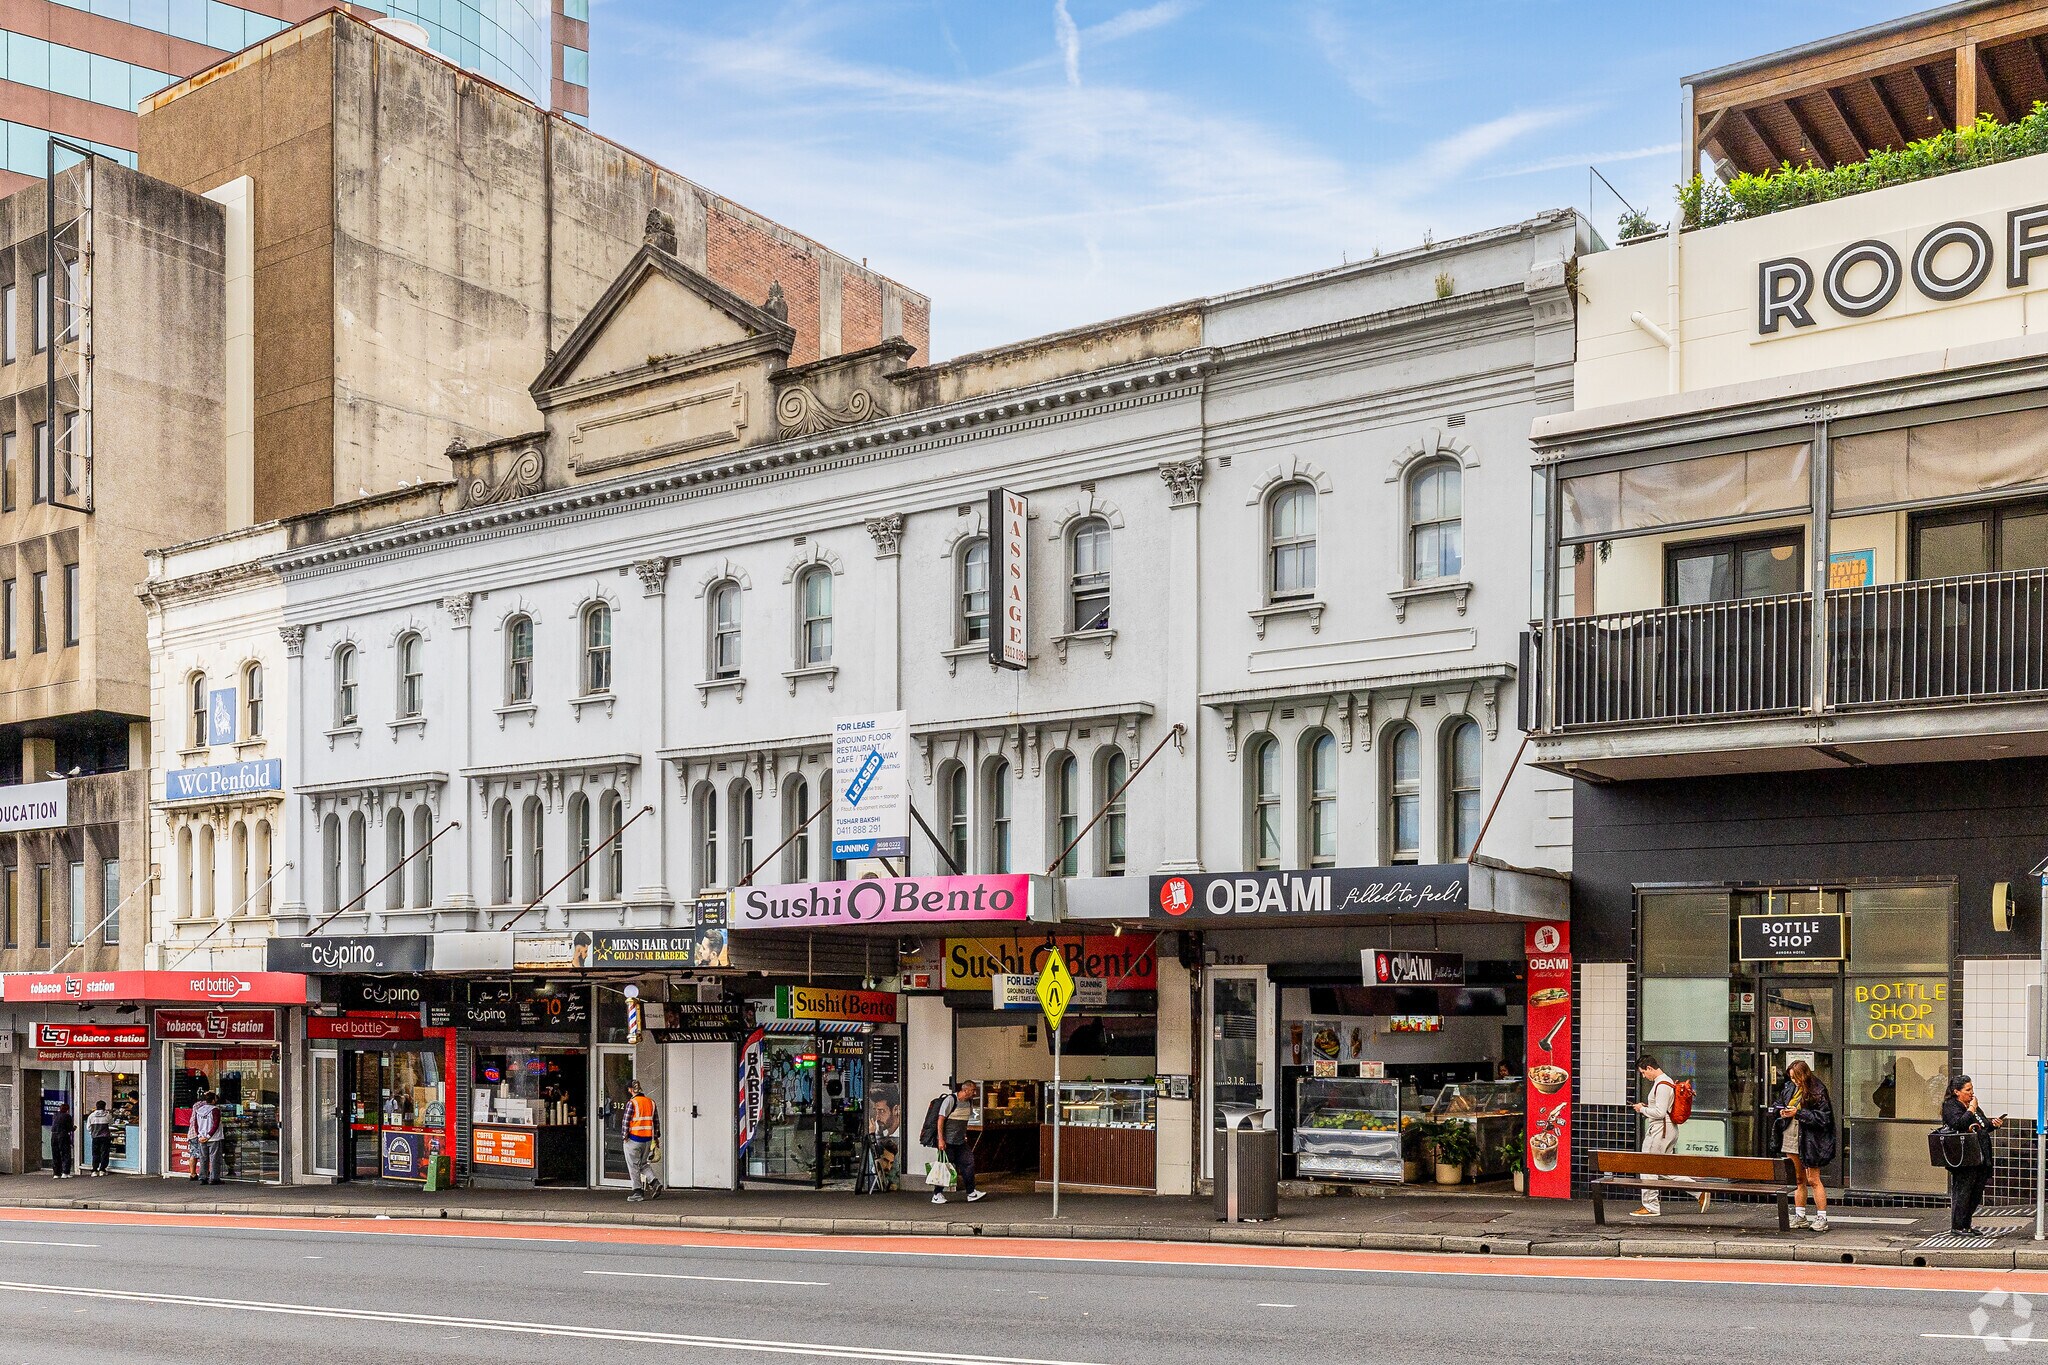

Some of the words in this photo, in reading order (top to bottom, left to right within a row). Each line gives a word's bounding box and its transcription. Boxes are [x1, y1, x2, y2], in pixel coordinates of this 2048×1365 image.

[1008, 496, 1023, 645] MASSAGE
[1830, 558, 1867, 577] RIVIA
[836, 723, 852, 731] FOR
[852, 720, 875, 730] LEASE
[836, 734, 867, 745] GROUND
[868, 732, 892, 742] FLOOR
[836, 743, 881, 755] RESTAURANT
[836, 755, 854, 764] CAFE
[177, 772, 208, 796] WC
[209, 762, 271, 793] Penfold
[848, 755, 880, 802] LEASED
[836, 817, 859, 825] TUSHAR
[859, 815, 881, 824] BAKSHI
[836, 826, 851, 836] 0411
[852, 825, 867, 835] 888
[868, 824, 881, 833] 291
[835, 843, 870, 854] GUNNING
[1205, 872, 1332, 915] OBA'MI
[1339, 882, 1402, 910] filled
[1398, 882, 1418, 903] to
[1412, 880, 1463, 908] feel!
[745, 887, 842, 921] Sushi
[891, 882, 1015, 913] Bento
[1761, 921, 1820, 935] BOTTLE
[611, 938, 639, 951] MENS
[641, 938, 668, 951] HAIR
[670, 938, 693, 950] CUT
[1769, 935, 1813, 948] SHOP
[613, 951, 634, 961] GOLD
[635, 951, 653, 960] STAR
[655, 951, 689, 960] BARBERS
[951, 944, 1023, 979] Sushi
[1063, 942, 1151, 979] Bento
[1529, 957, 1569, 970] OBA'MI
[30, 982, 62, 994] tobacco
[65, 975, 83, 998] tsg
[86, 979, 115, 993] station
[189, 978, 206, 992] red
[206, 977, 235, 992] bottle
[1006, 976, 1021, 986] FOR
[1021, 976, 1040, 986] LEAS
[1079, 980, 1103, 989] GUNNING
[1006, 987, 1026, 995] GROUND
[1855, 982, 1947, 1003] BOTTLE
[680, 1004, 703, 1014] MENS
[704, 1004, 723, 1014] HAIR
[724, 1004, 739, 1014] CUT
[796, 992, 840, 1012] Sushi
[849, 996, 896, 1016] Bento
[1869, 1003, 1933, 1020] SHOP
[166, 1020, 202, 1032] tobacco
[207, 1011, 229, 1039] tsg
[231, 1020, 264, 1033] station
[331, 1021, 349, 1032] red
[350, 1021, 382, 1033] bottle
[1868, 1023, 1935, 1040] OPEN
[41, 1025, 70, 1047] tsg
[73, 1033, 111, 1044] tobacco
[113, 1033, 146, 1043] station
[669, 1032, 692, 1042] MENS
[693, 1032, 713, 1042] HAIR
[713, 1032, 729, 1042] CUT
[816, 1039, 834, 1055] $17
[833, 1047, 864, 1055] WELCOME
[921, 1062, 935, 1071] 316
[1226, 1076, 1245, 1085] 318
[746, 1052, 760, 1133] BARBER
[1685, 1143, 1691, 1151] 2
